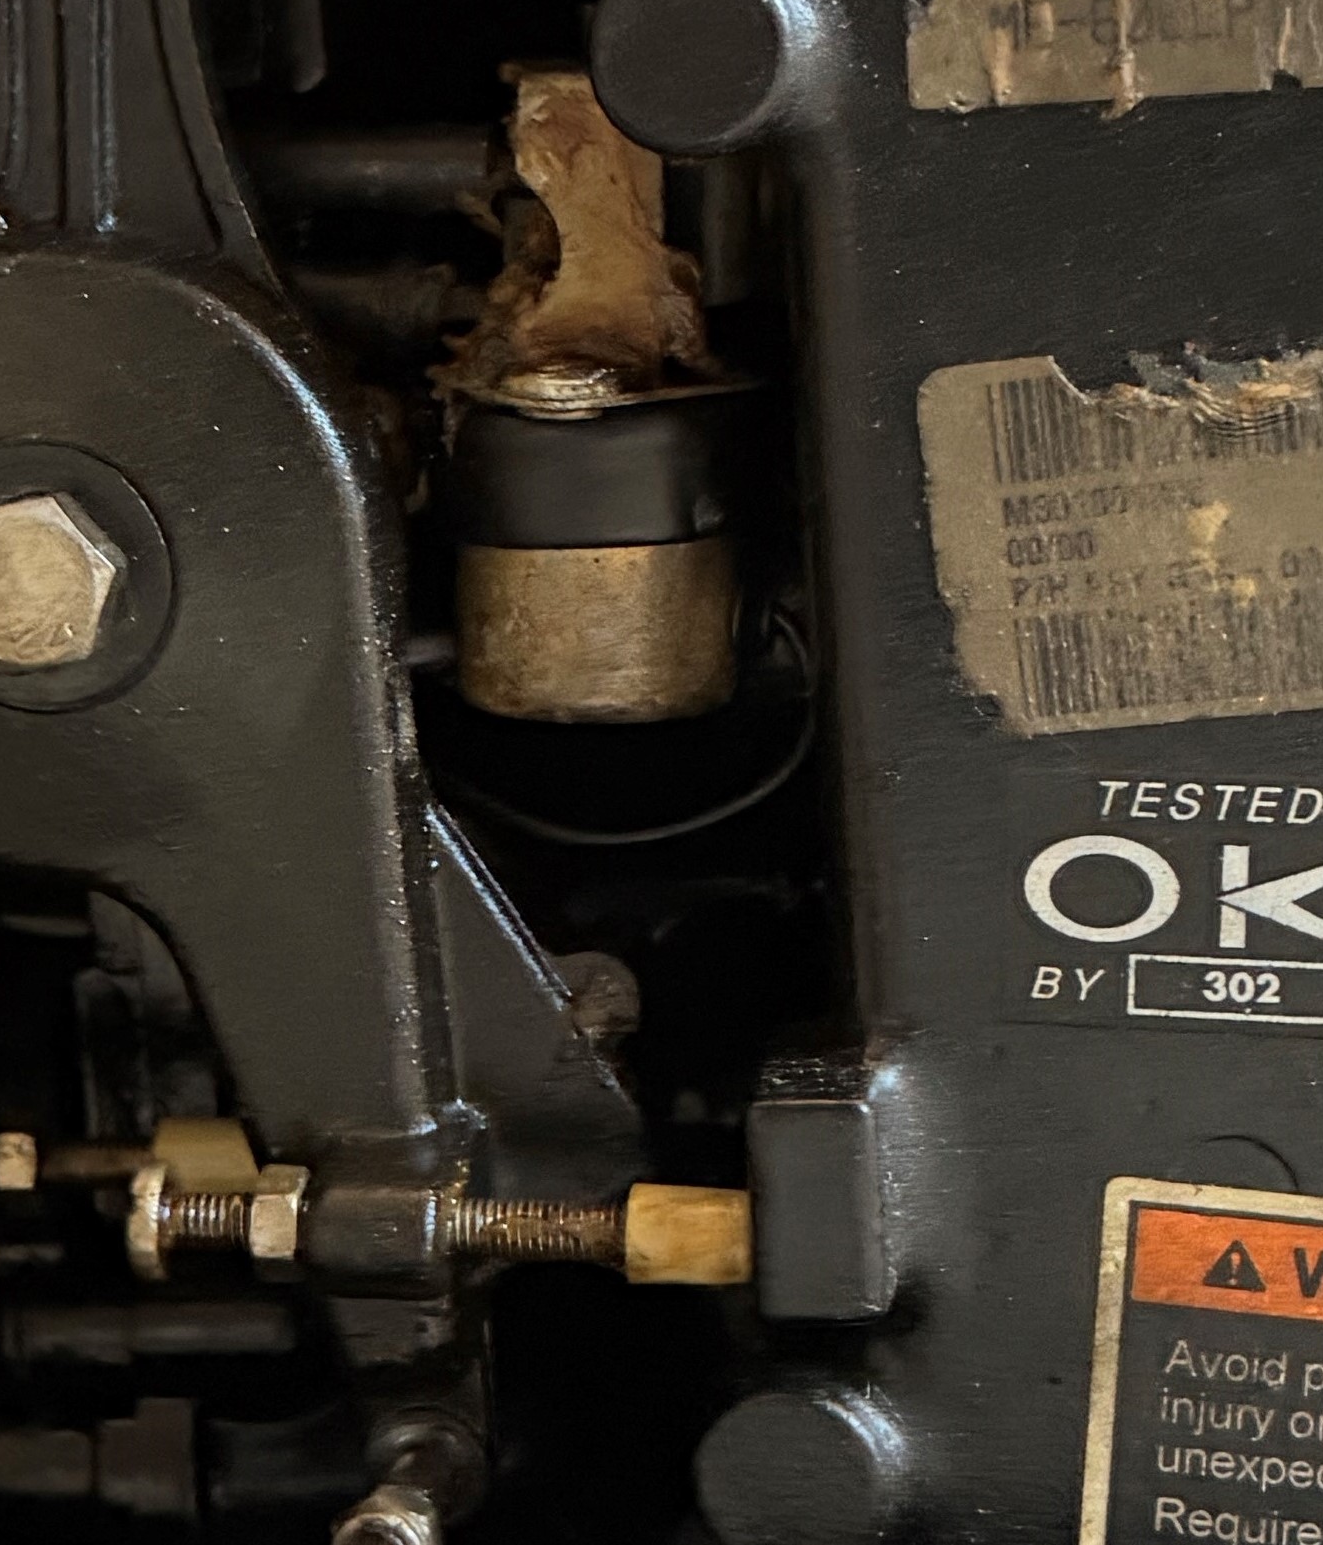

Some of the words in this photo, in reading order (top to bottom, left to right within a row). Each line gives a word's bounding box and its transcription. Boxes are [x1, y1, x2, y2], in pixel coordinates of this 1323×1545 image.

[1030, 965, 1106, 1000] BY
[1202, 970, 1281, 1004] 302
[1165, 1338, 1289, 1388] Avoid
[1160, 1387, 1276, 1442] injury
